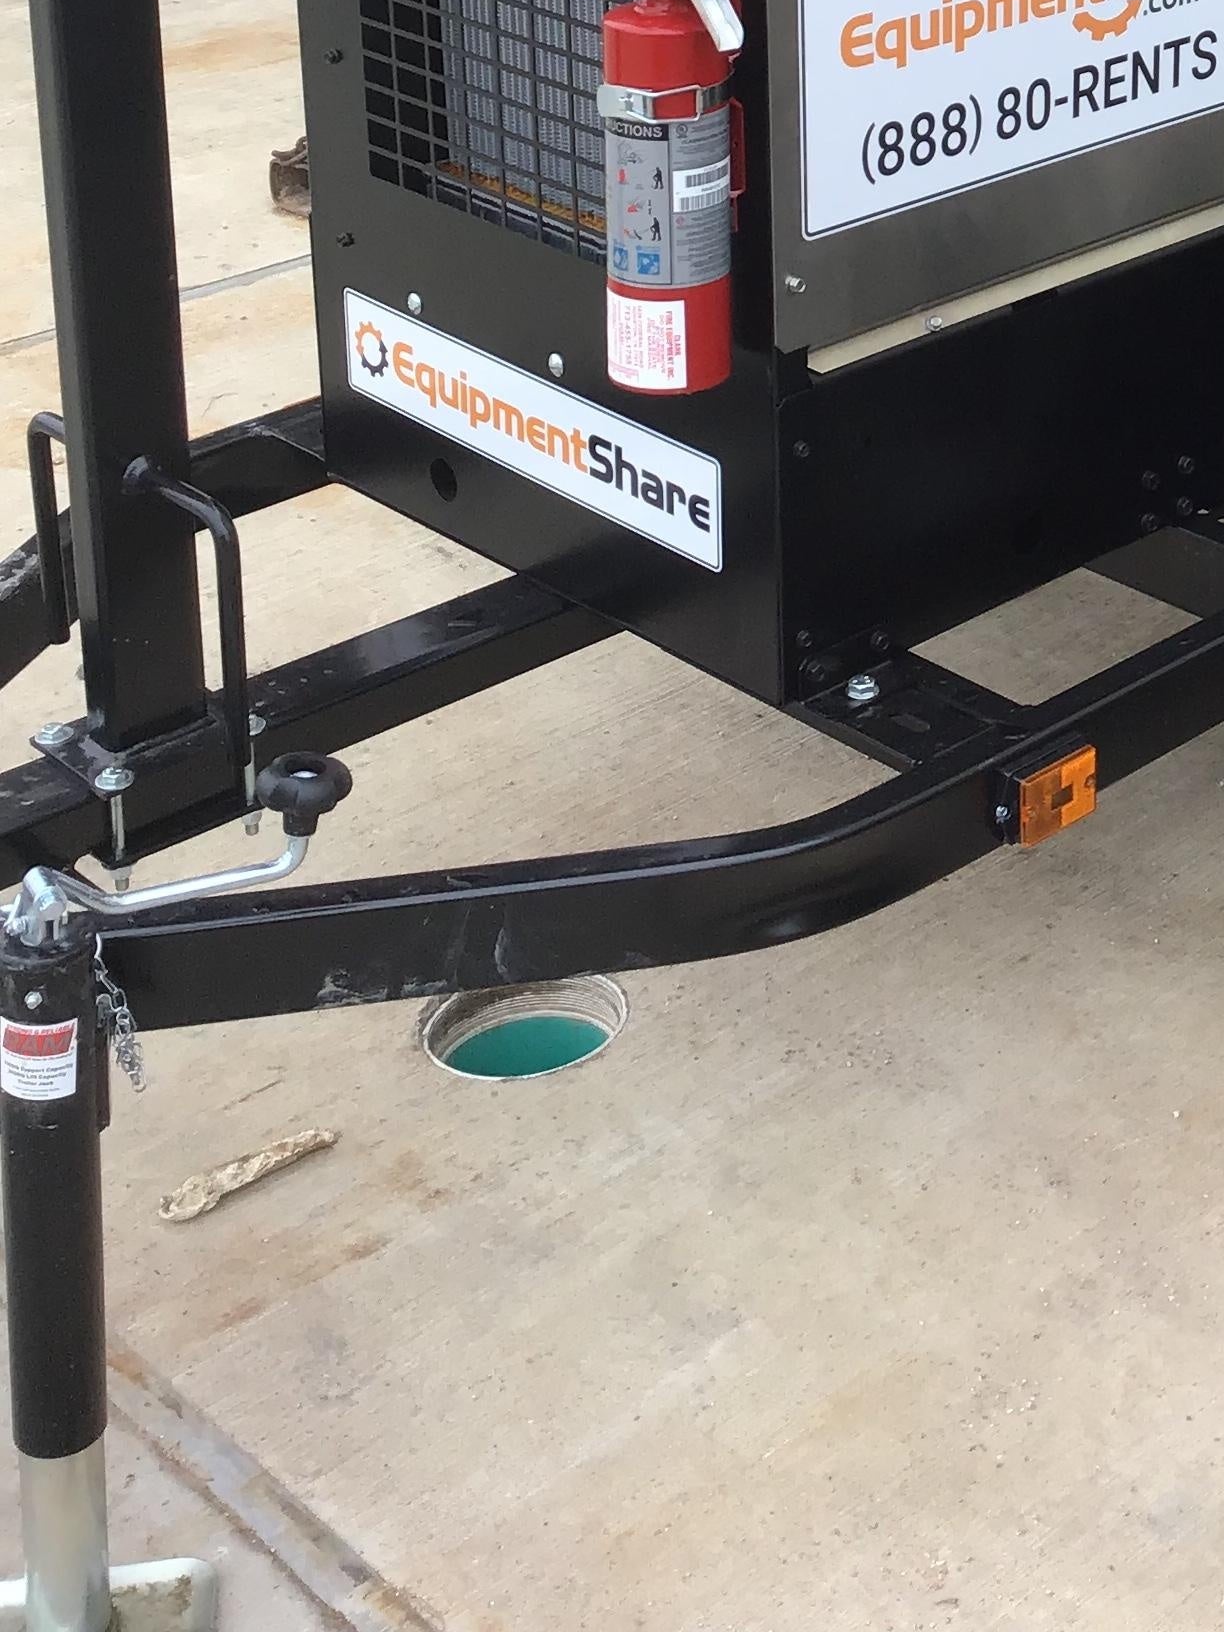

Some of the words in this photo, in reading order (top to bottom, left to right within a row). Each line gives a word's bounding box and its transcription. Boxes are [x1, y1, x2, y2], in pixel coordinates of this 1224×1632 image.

[862, 93, 983, 186] (888)
[995, 29, 1218, 141] 80-RENTS
[391, 341, 711, 533] EquipmentShare
